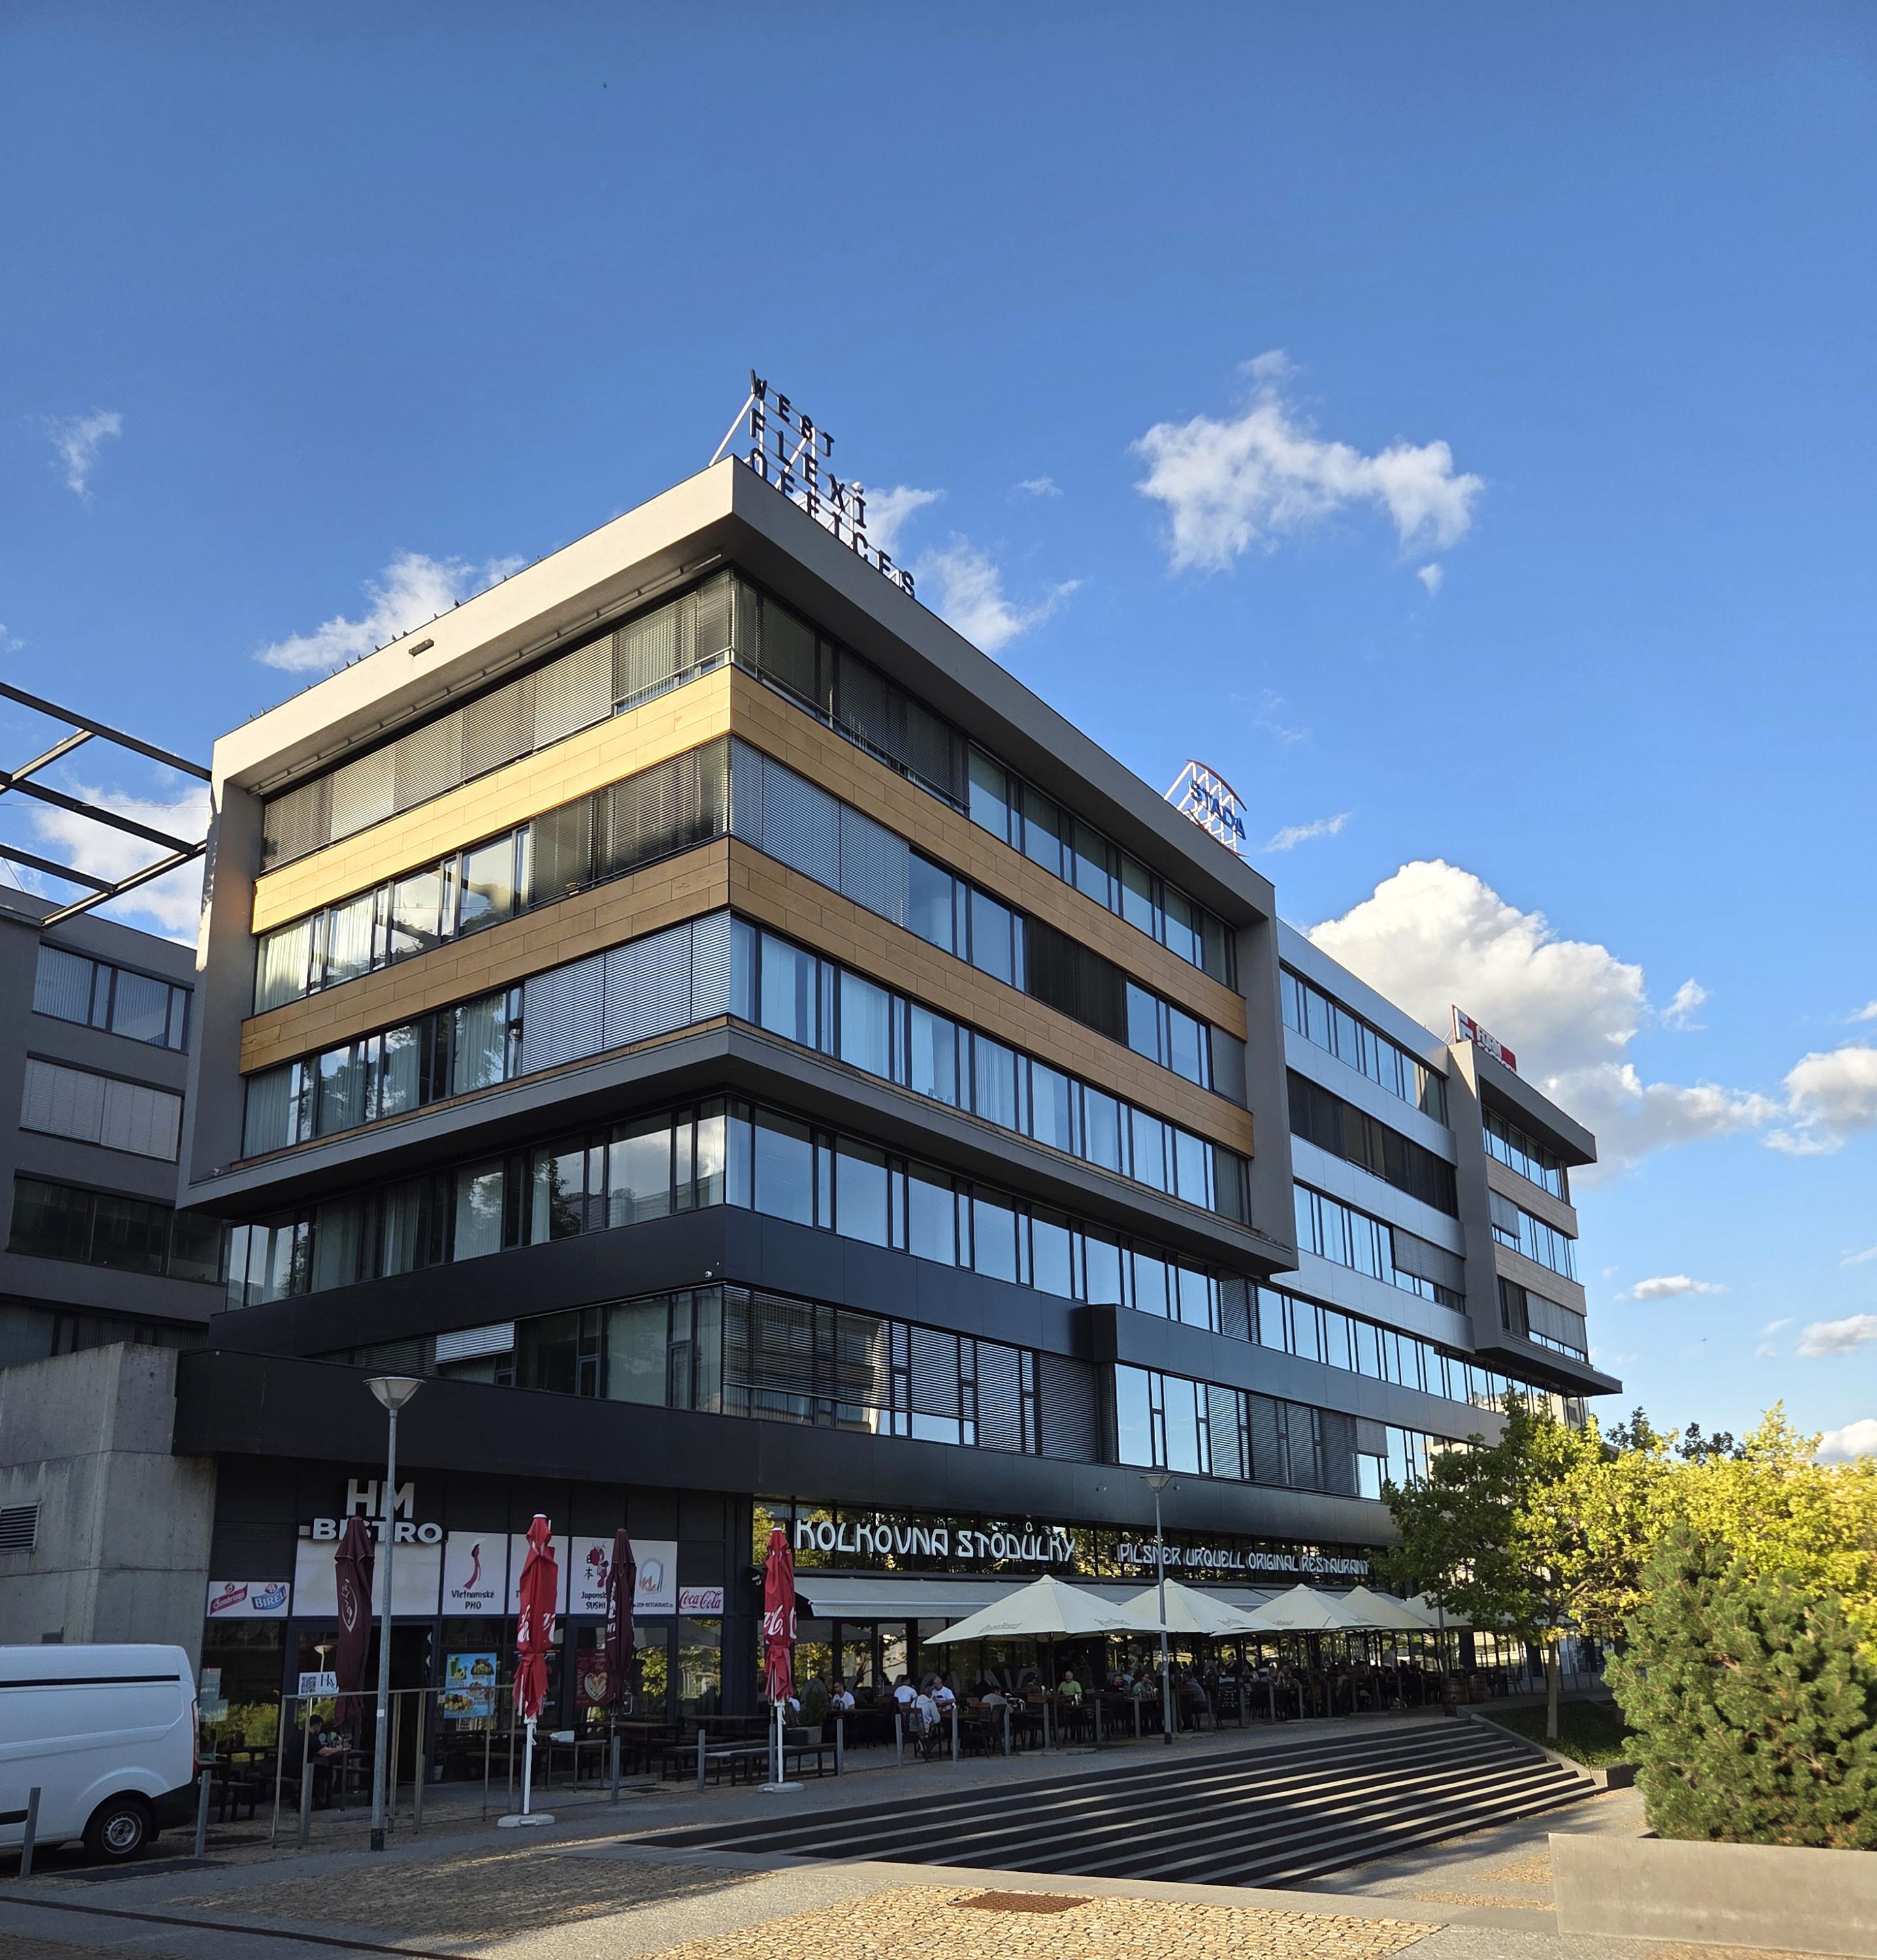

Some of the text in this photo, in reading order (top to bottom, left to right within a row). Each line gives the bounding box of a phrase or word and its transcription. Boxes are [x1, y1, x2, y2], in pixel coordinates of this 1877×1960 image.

[750, 368, 835, 457] WEST
[750, 408, 866, 529] FLEXI
[751, 448, 915, 599] OFFICES
[1189, 779, 1246, 840] STADA
[346, 1478, 415, 1518] HM
[793, 1519, 1077, 1562] KOLKOVNA STODŮLKY
[1118, 1543, 1370, 1575] PILSNER URQUELL ORIGINAL RESTAURANT
[451, 1590, 495, 1599] Vietnamské
[465, 1601, 481, 1609] PHO
[581, 1591, 607, 1600] Japonsk
[585, 1601, 606, 1610] SUSHI
[679, 1590, 722, 1609] Coca-Cola
